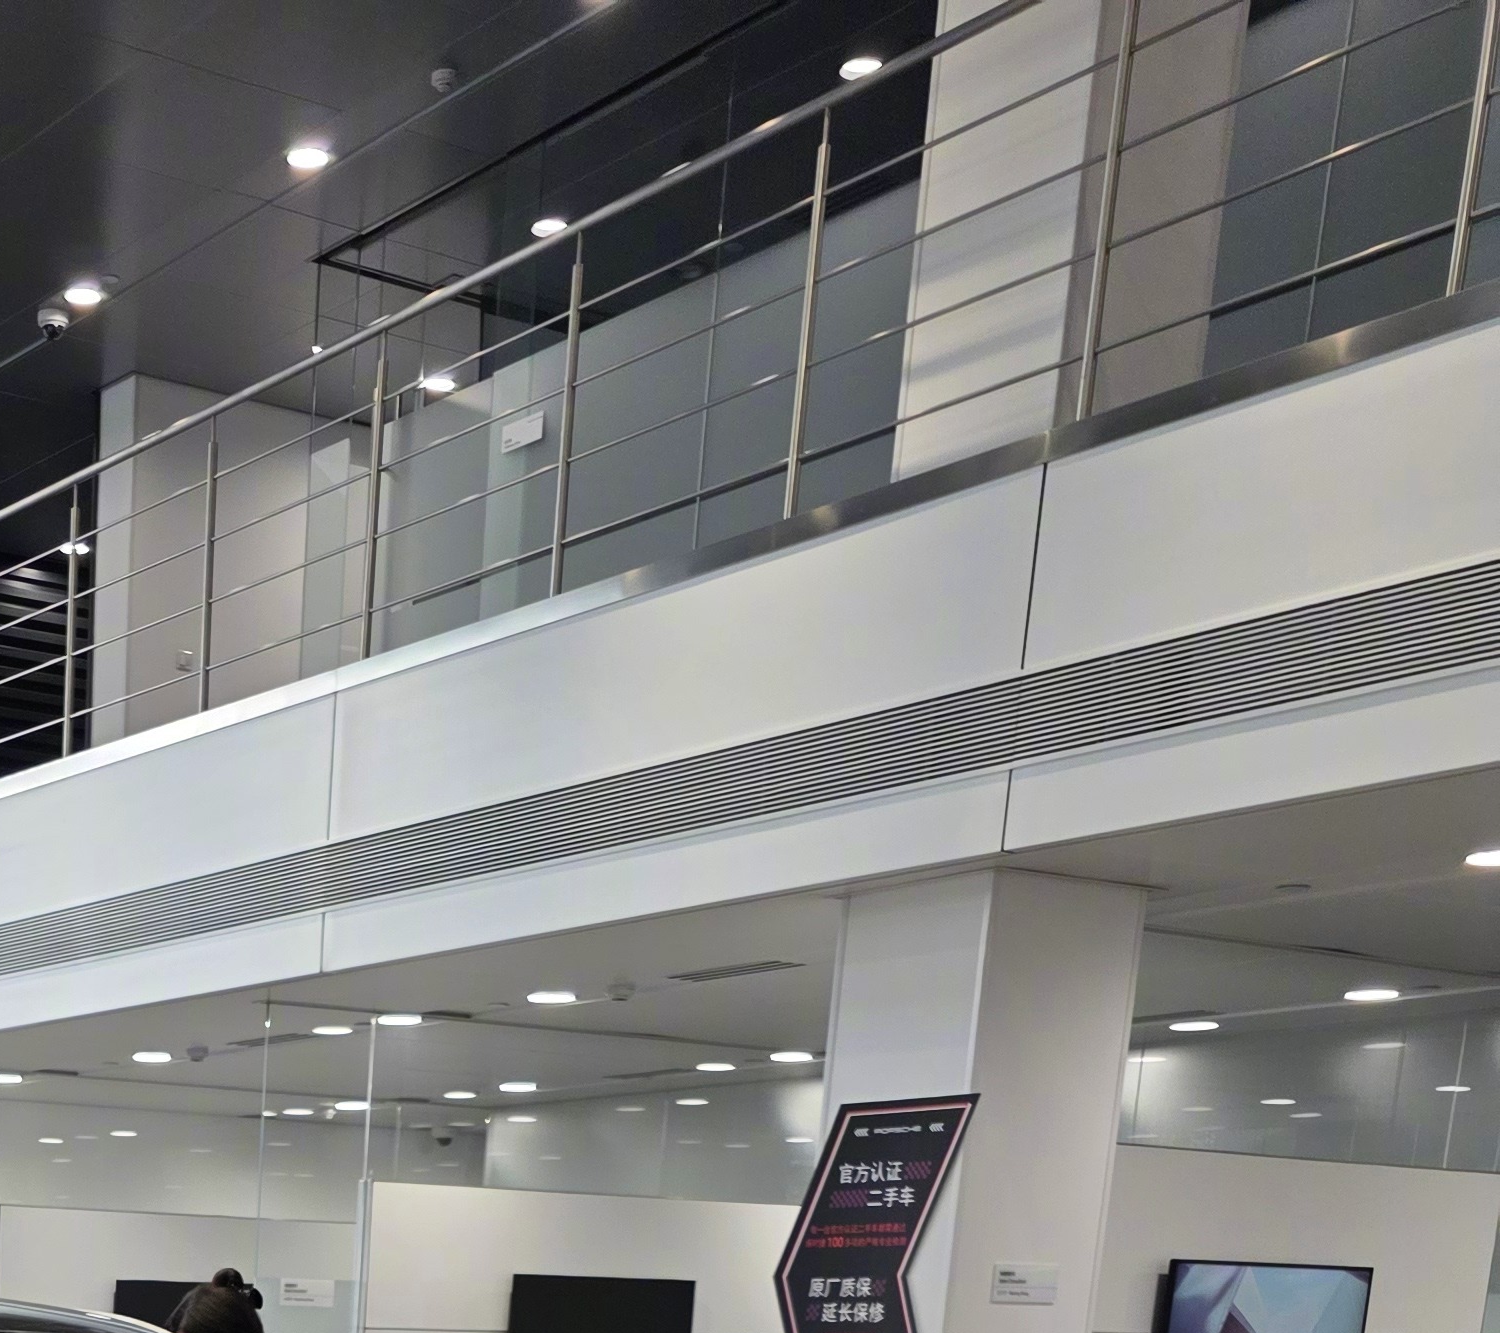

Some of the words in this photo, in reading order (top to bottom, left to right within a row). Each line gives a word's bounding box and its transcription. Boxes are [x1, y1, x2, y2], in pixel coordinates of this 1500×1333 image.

[838, 1161, 904, 1185] 官方认证
[866, 1185, 916, 1208] 二手车
[808, 1276, 873, 1298] 原厂质保
[821, 1302, 885, 1323] 延长保修
